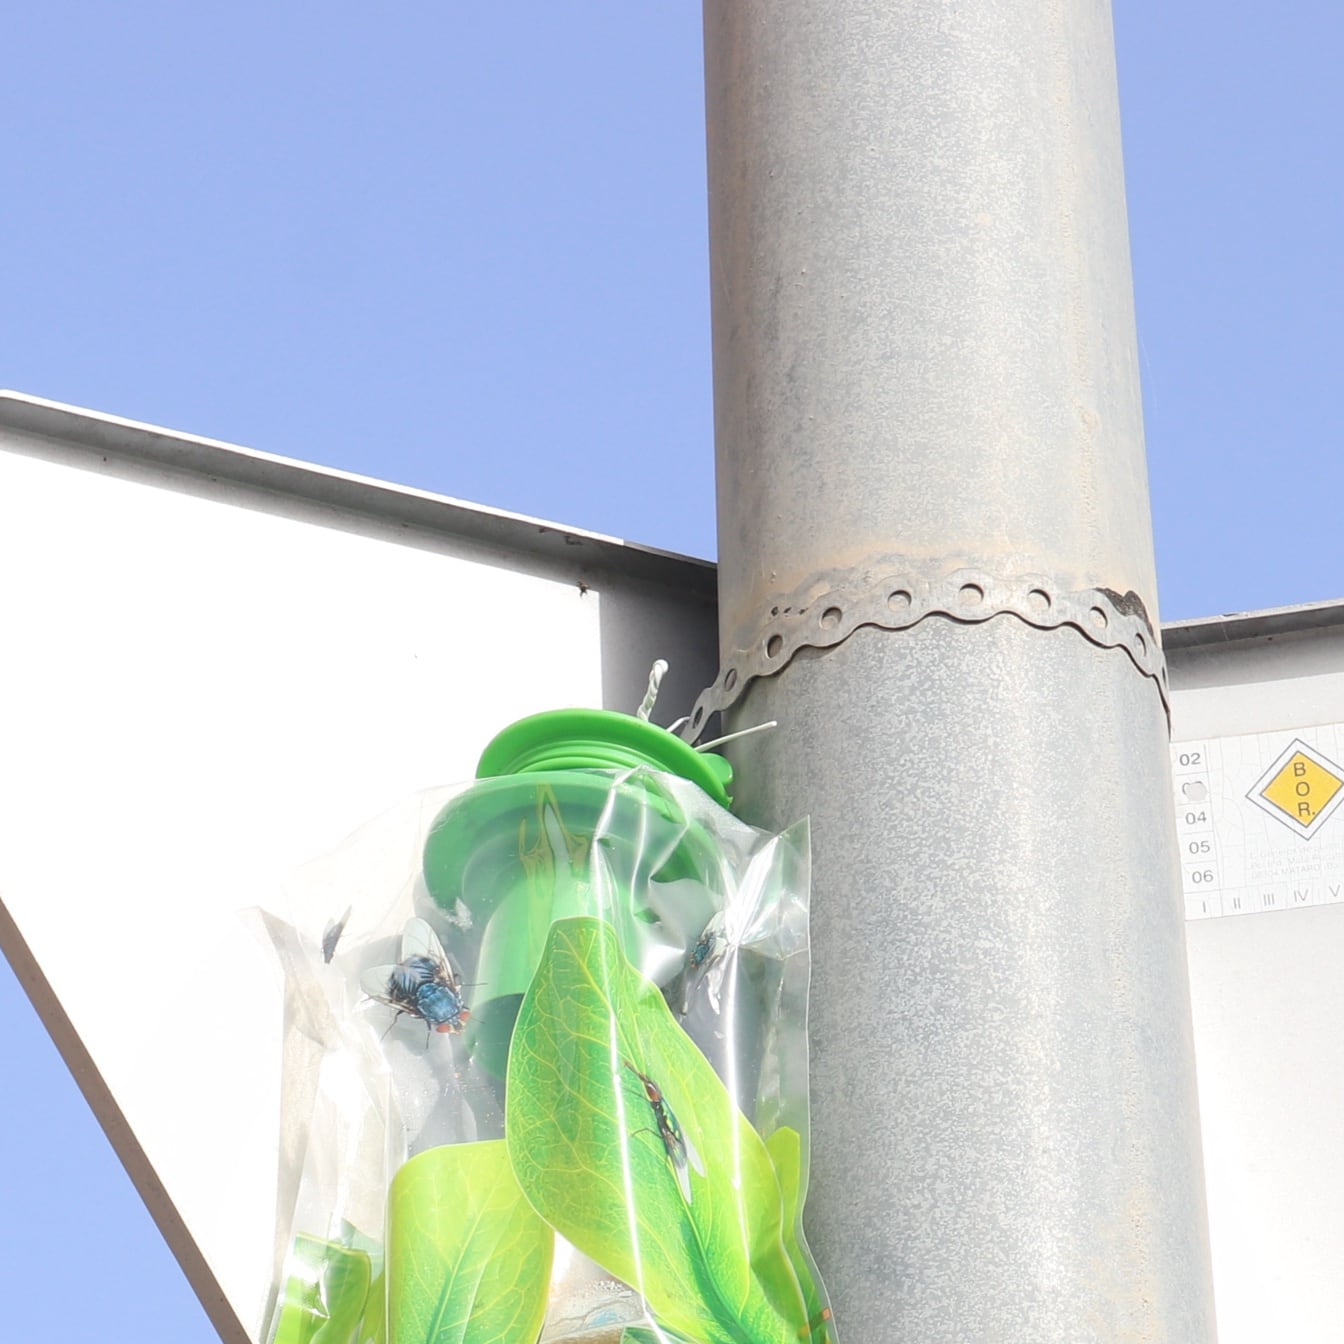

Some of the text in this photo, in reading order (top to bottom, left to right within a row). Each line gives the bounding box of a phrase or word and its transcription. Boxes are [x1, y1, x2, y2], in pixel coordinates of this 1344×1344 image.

[1179, 752, 1201, 767] 02
[1185, 811, 1207, 825] 04
[1188, 840, 1211, 855] 05
[1192, 869, 1214, 884] 06
[1233, 897, 1241, 910] II
[1263, 893, 1275, 907] III
[1293, 889, 1309, 903] IV
[1328, 884, 1341, 897] V
